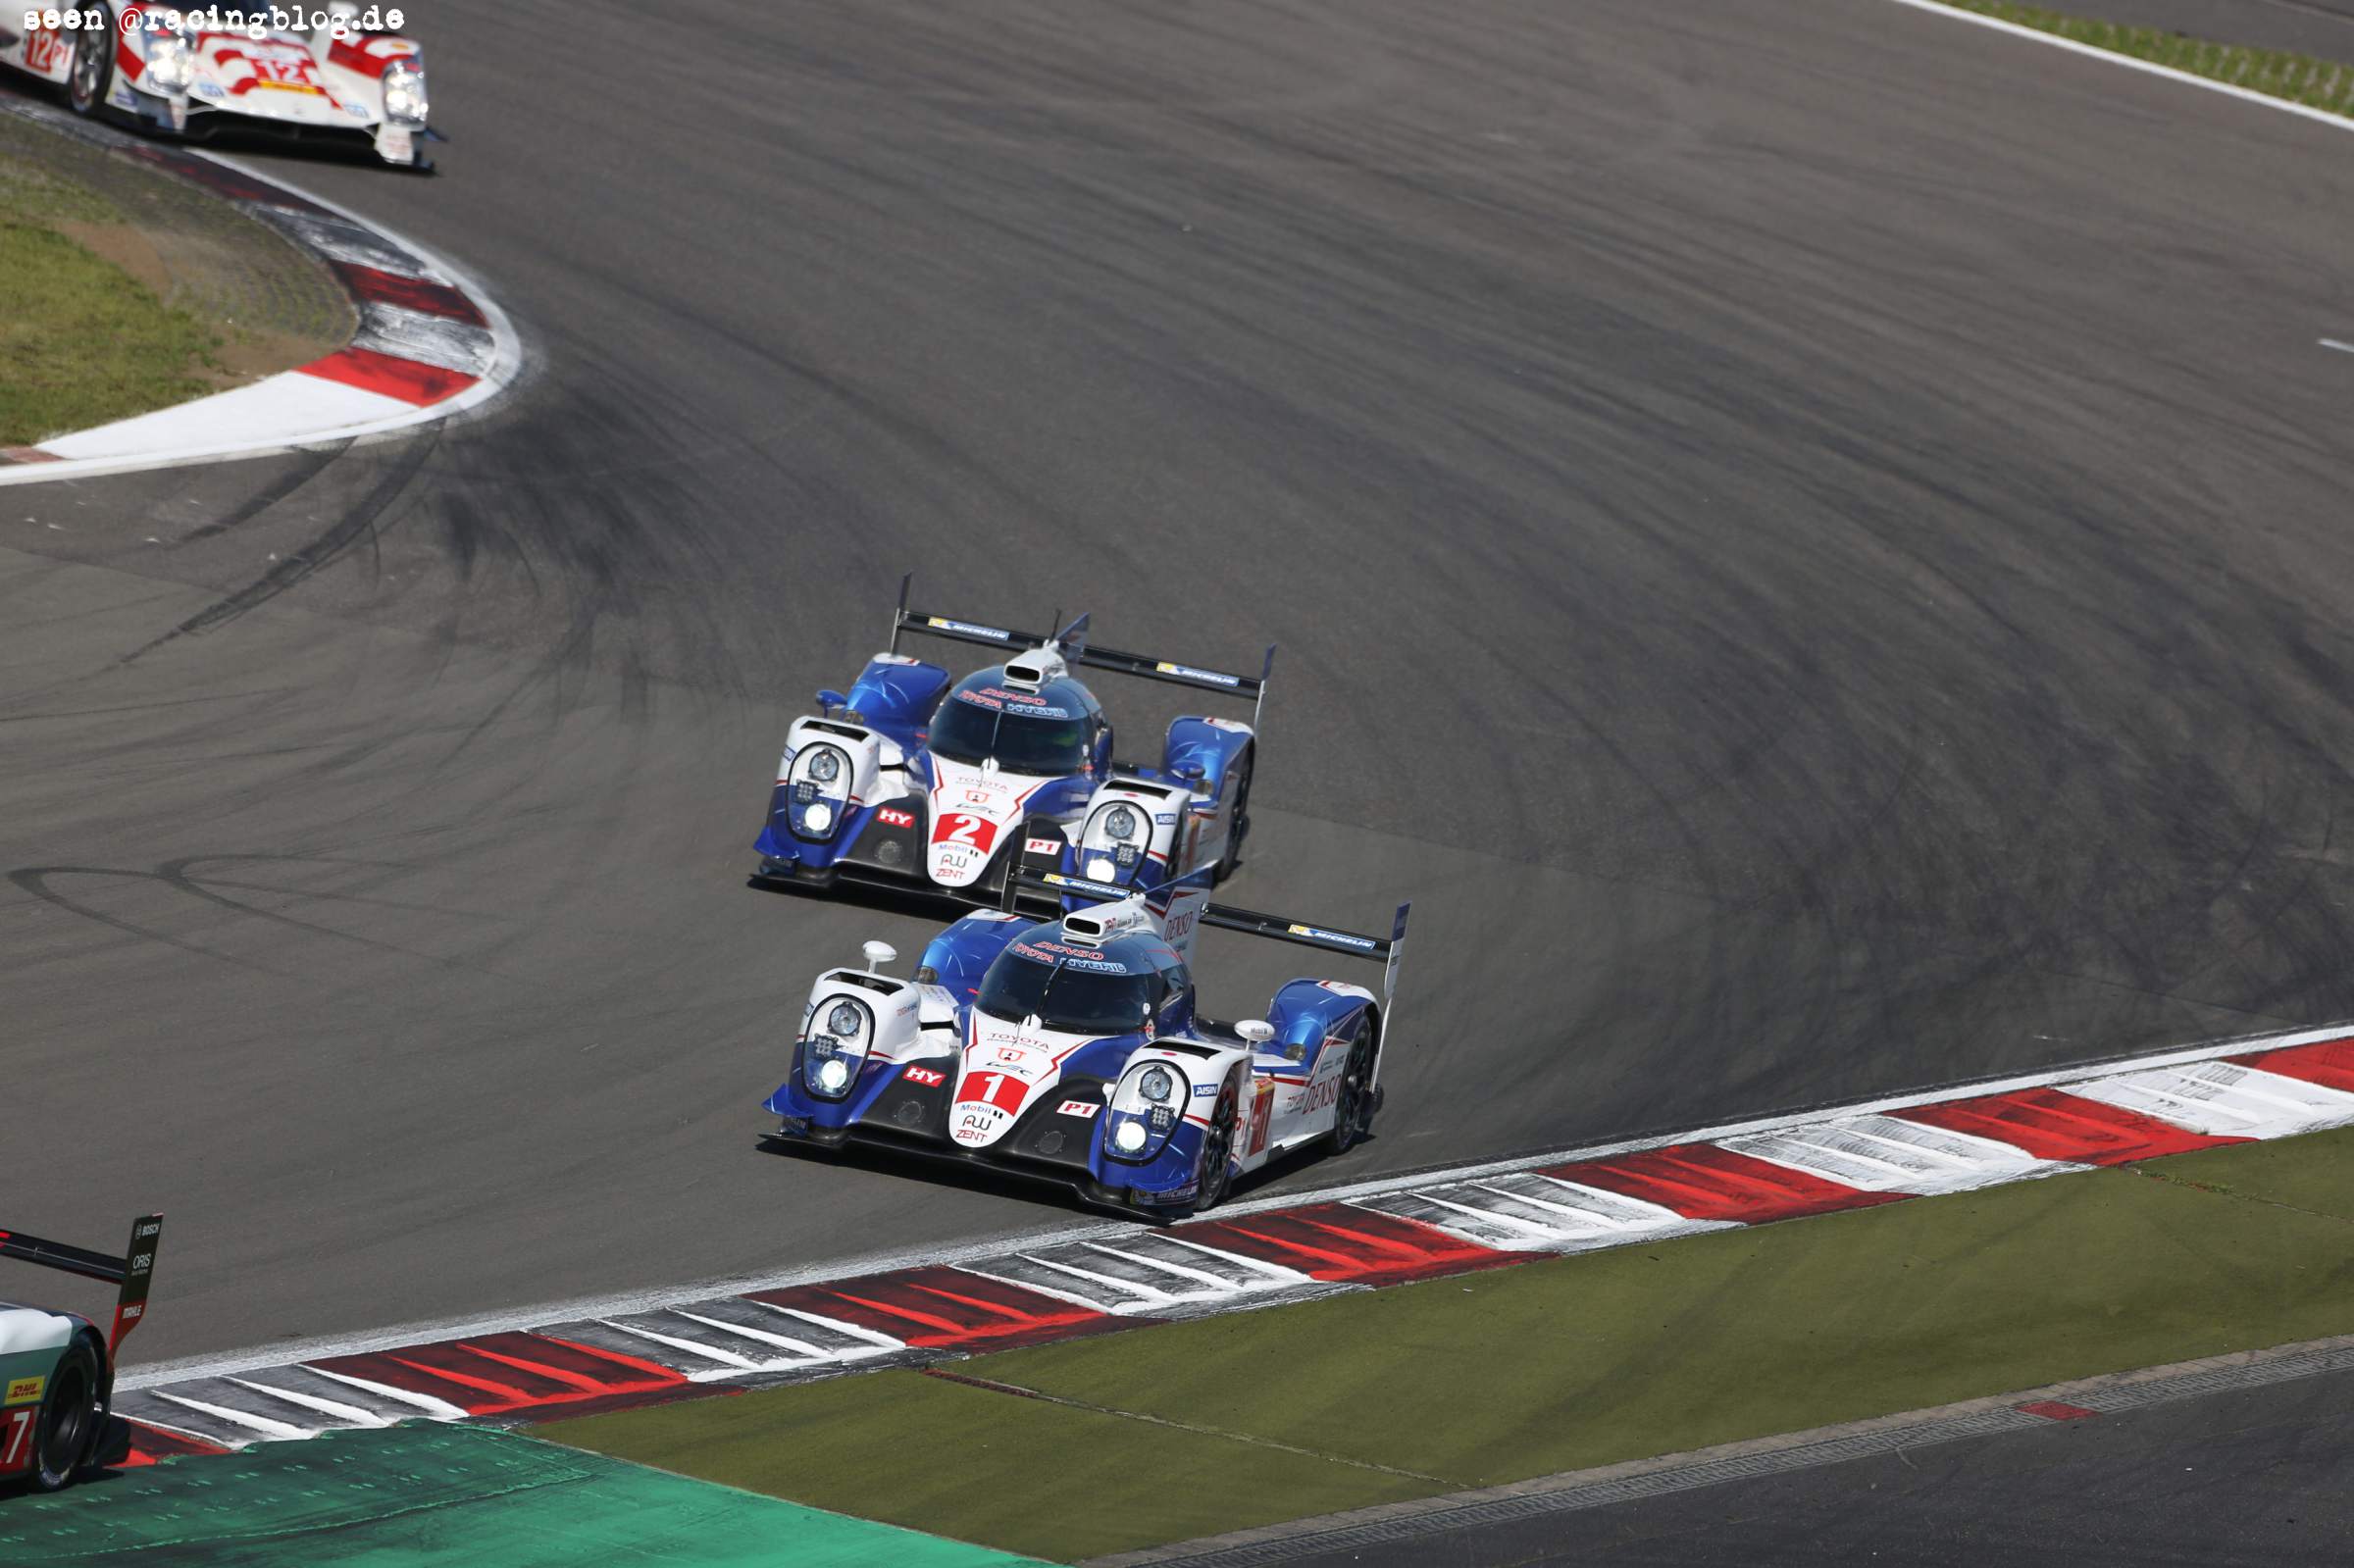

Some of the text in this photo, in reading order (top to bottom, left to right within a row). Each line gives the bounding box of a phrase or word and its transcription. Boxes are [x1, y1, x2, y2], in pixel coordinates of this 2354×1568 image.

[30, 30, 54, 68] 12
[257, 60, 305, 82] 12
[980, 687, 1047, 706] DENSO
[879, 809, 912, 825] HY
[947, 815, 982, 845] 2
[1028, 840, 1054, 852] P1
[936, 869, 965, 880] ZENT
[1069, 880, 1128, 896] MICHELIN
[1164, 911, 1194, 941] DENSO
[1315, 932, 1373, 947] MICHELIN
[1033, 941, 1104, 961] DENSO
[991, 1033, 1049, 1050] TOYOTA
[904, 1068, 943, 1084] HY
[982, 1075, 1005, 1103] 1
[1196, 1086, 1217, 1096] AISIN
[1303, 1074, 1343, 1115] DENSO
[960, 1103, 992, 1114] Mobil
[1063, 1103, 1093, 1115] P1
[955, 1130, 988, 1142] ZENT
[6, 1411, 30, 1464] 7
